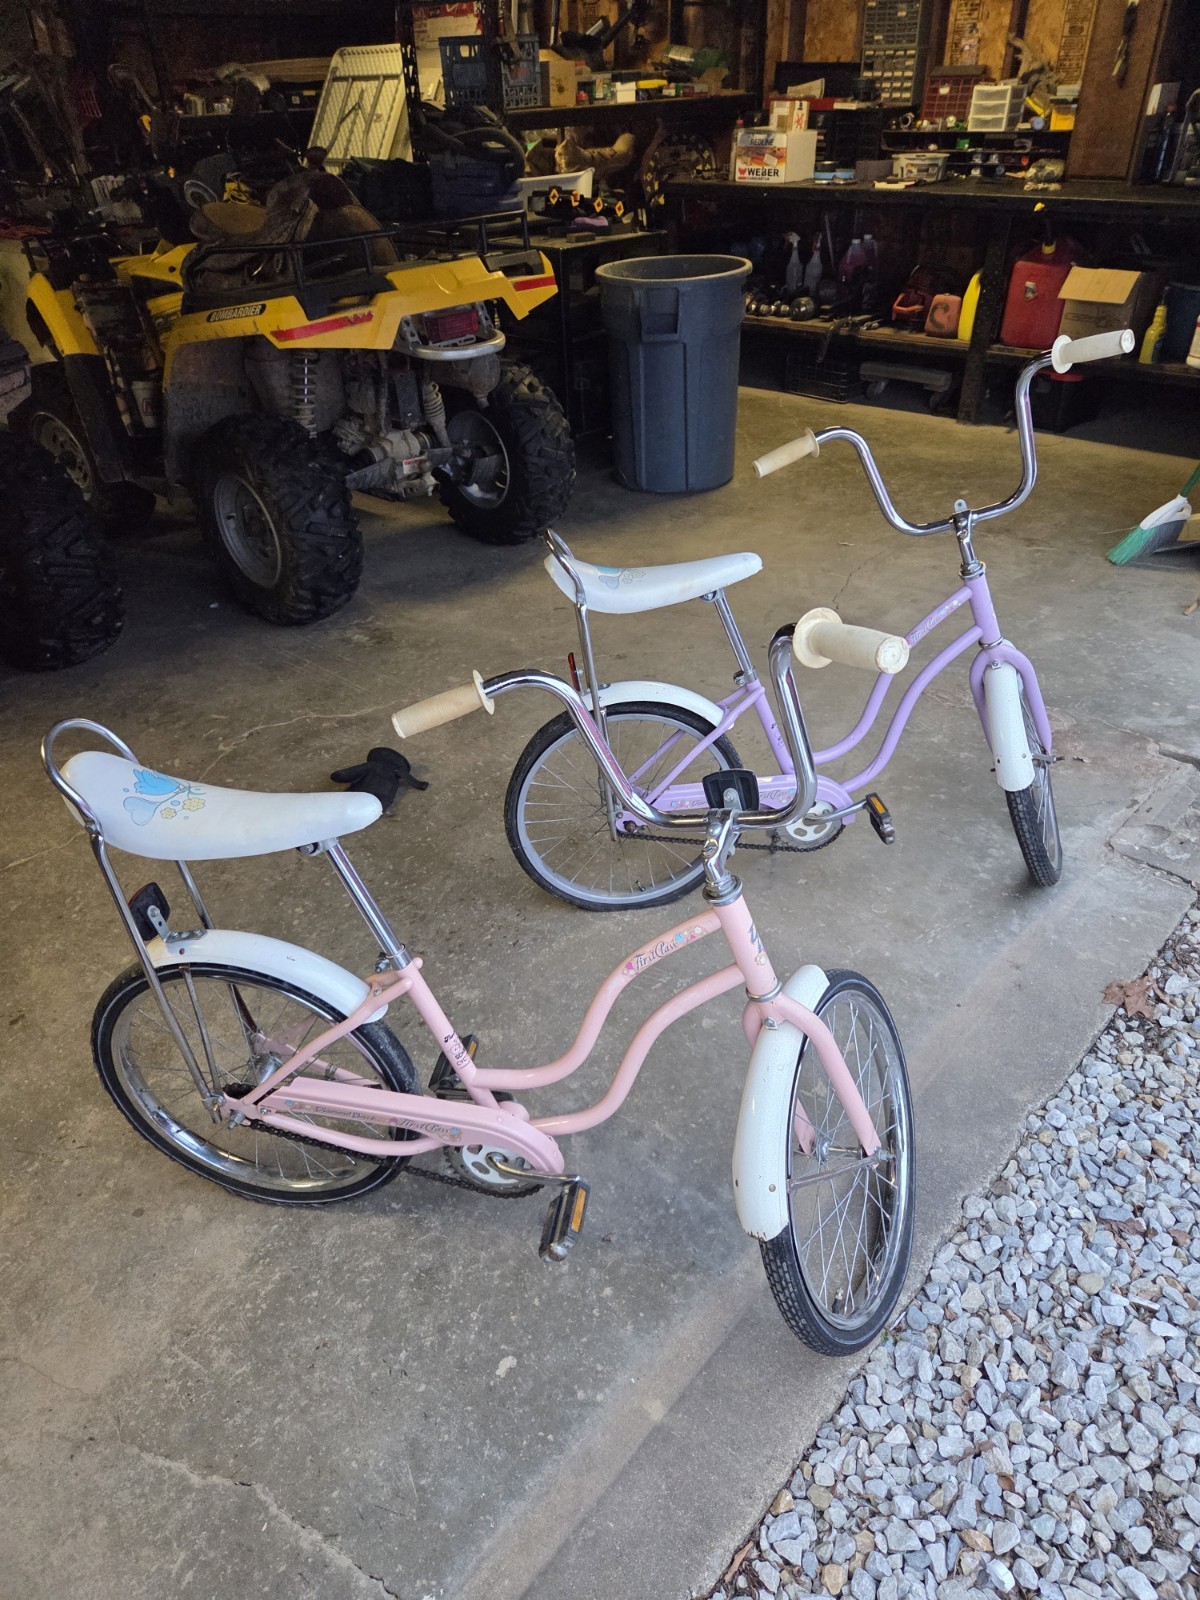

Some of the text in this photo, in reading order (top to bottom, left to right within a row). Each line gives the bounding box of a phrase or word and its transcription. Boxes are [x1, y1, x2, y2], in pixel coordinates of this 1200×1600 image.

[751, 138, 775, 146] REDLINE
[747, 167, 779, 177] WEBER
[209, 305, 262, 322] BOMBARDIER
